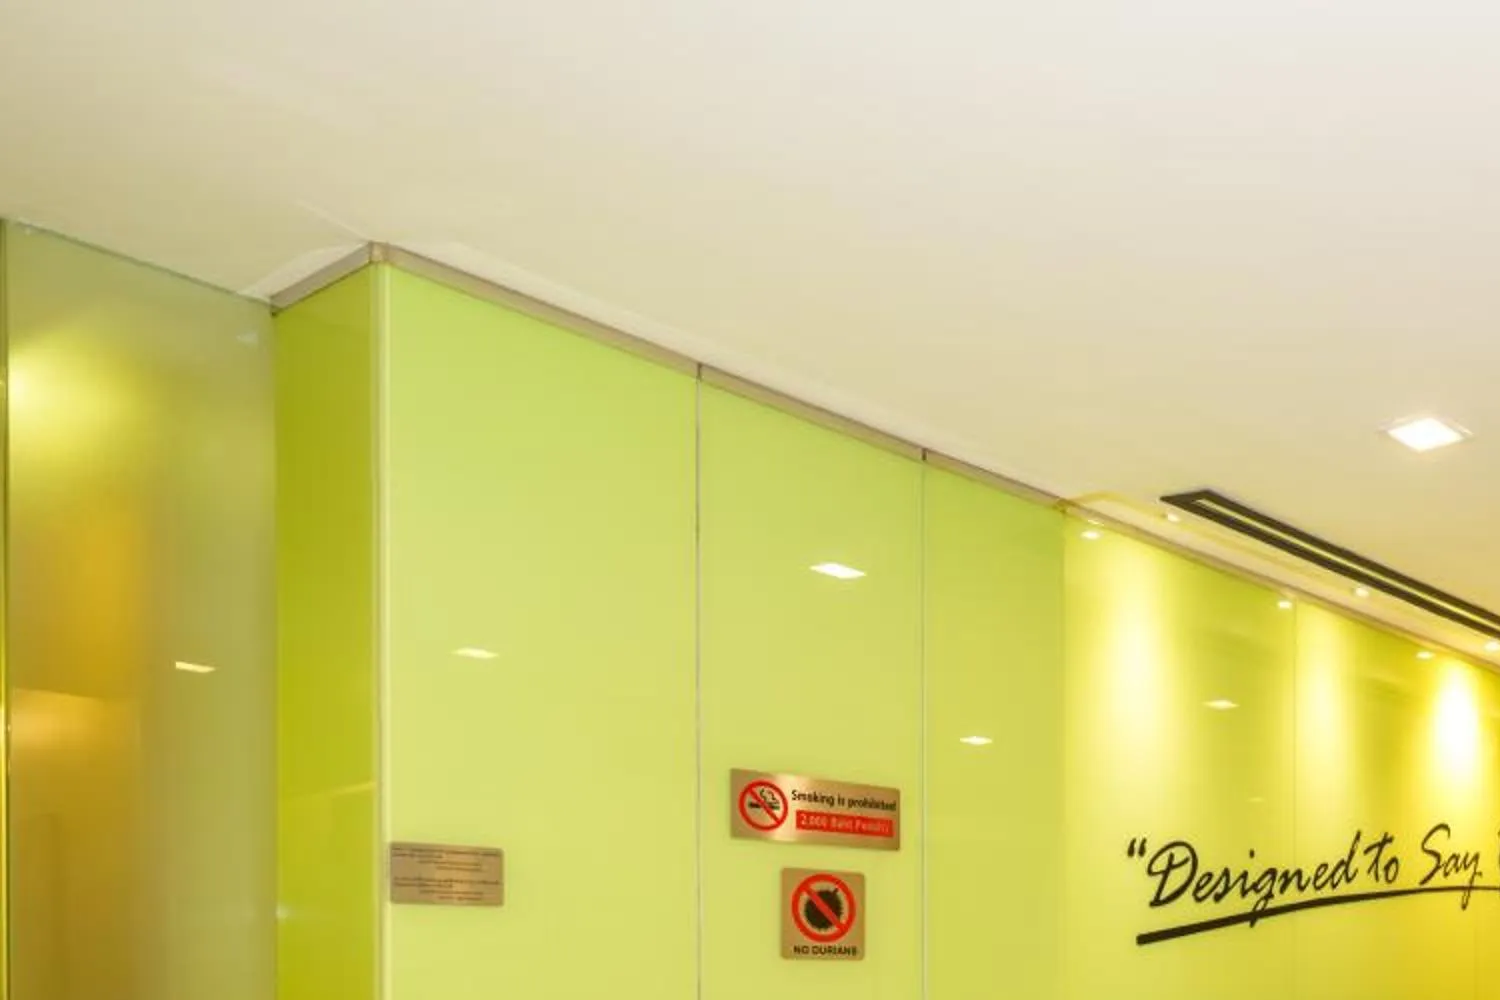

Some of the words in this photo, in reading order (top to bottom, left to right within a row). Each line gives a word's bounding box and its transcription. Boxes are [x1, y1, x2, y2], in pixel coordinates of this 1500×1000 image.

[791, 789, 835, 807] Smoking
[837, 792, 846, 807] is
[848, 797, 897, 812] prohibited
[1364, 832, 1399, 884] to
[1419, 823, 1482, 910] Say
[794, 945, 810, 955] NO
[812, 945, 857, 956] DURIANS
